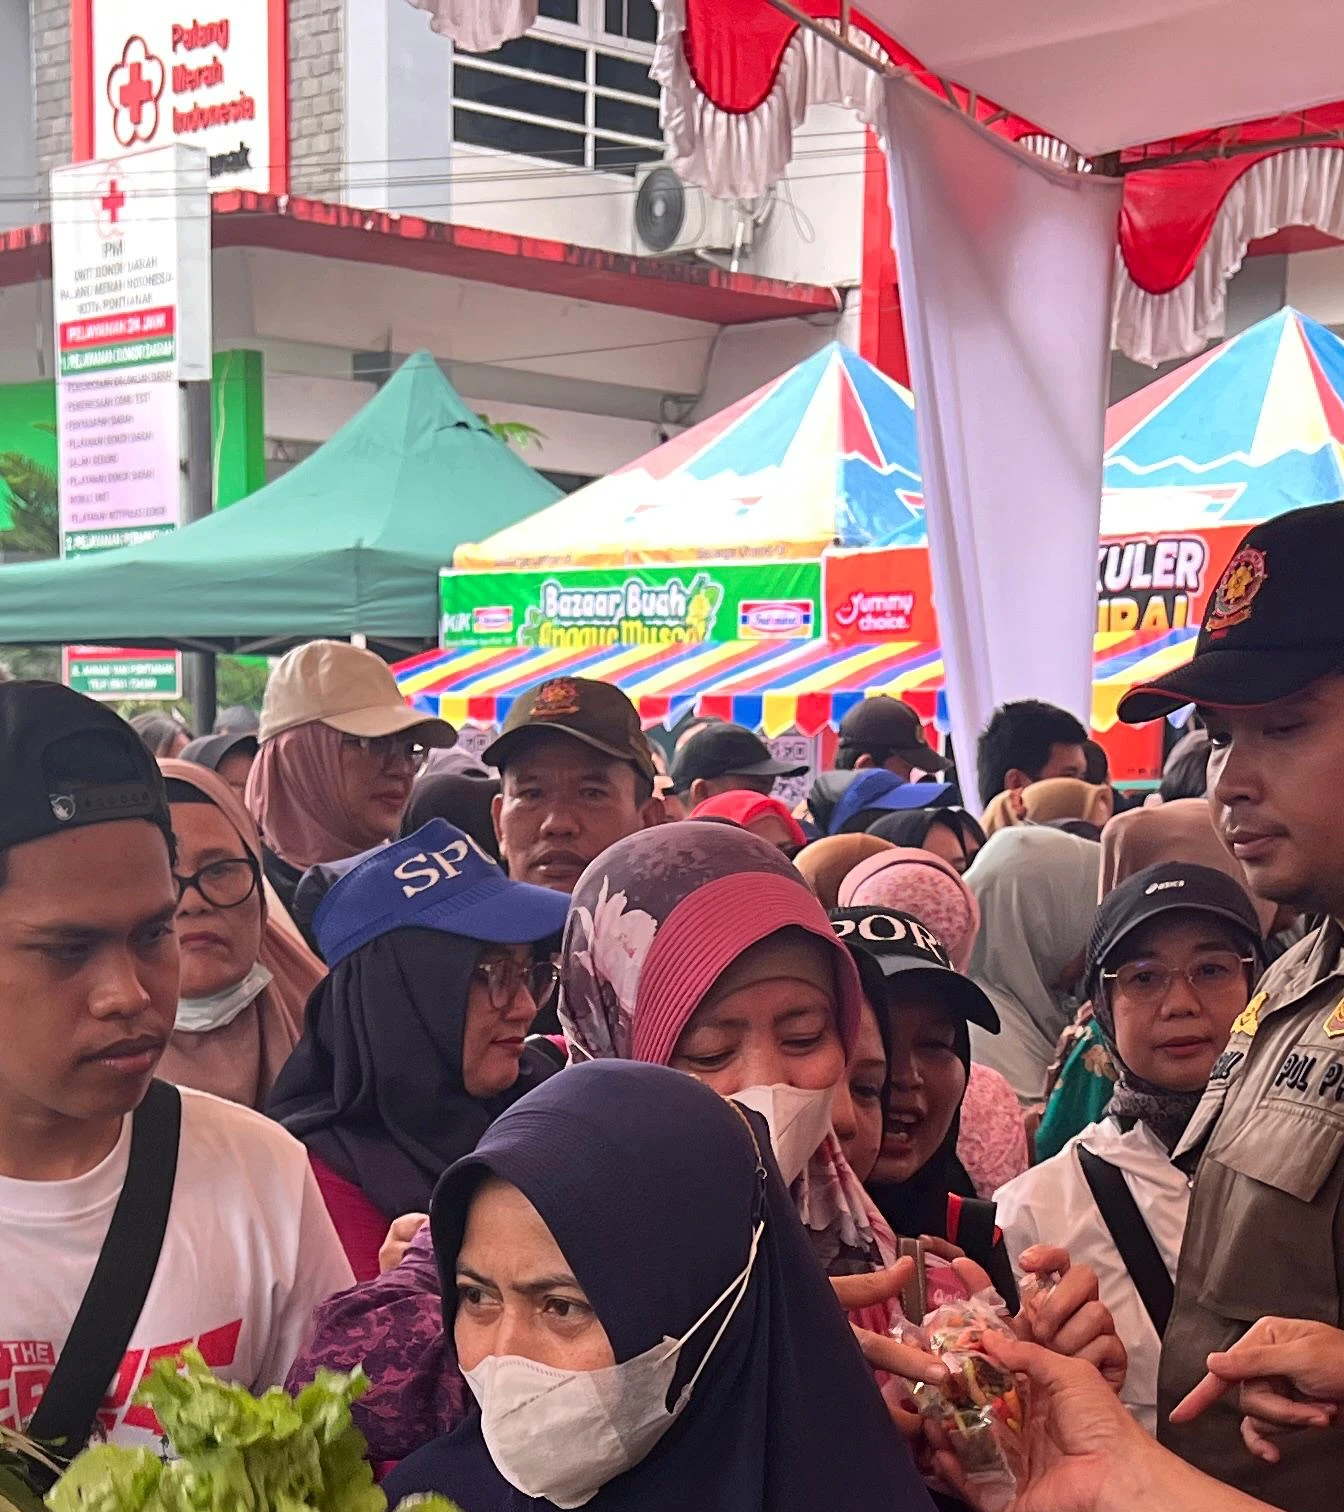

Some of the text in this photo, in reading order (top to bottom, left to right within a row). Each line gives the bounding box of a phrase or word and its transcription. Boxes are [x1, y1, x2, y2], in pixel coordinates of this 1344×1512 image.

[172, 19, 229, 52] Palang
[173, 91, 255, 134] Indonesia
[545, 581, 686, 618] Bazaar Buah
[1275, 1053, 1317, 1092] POL
[2, 1343, 50, 1364] THE
